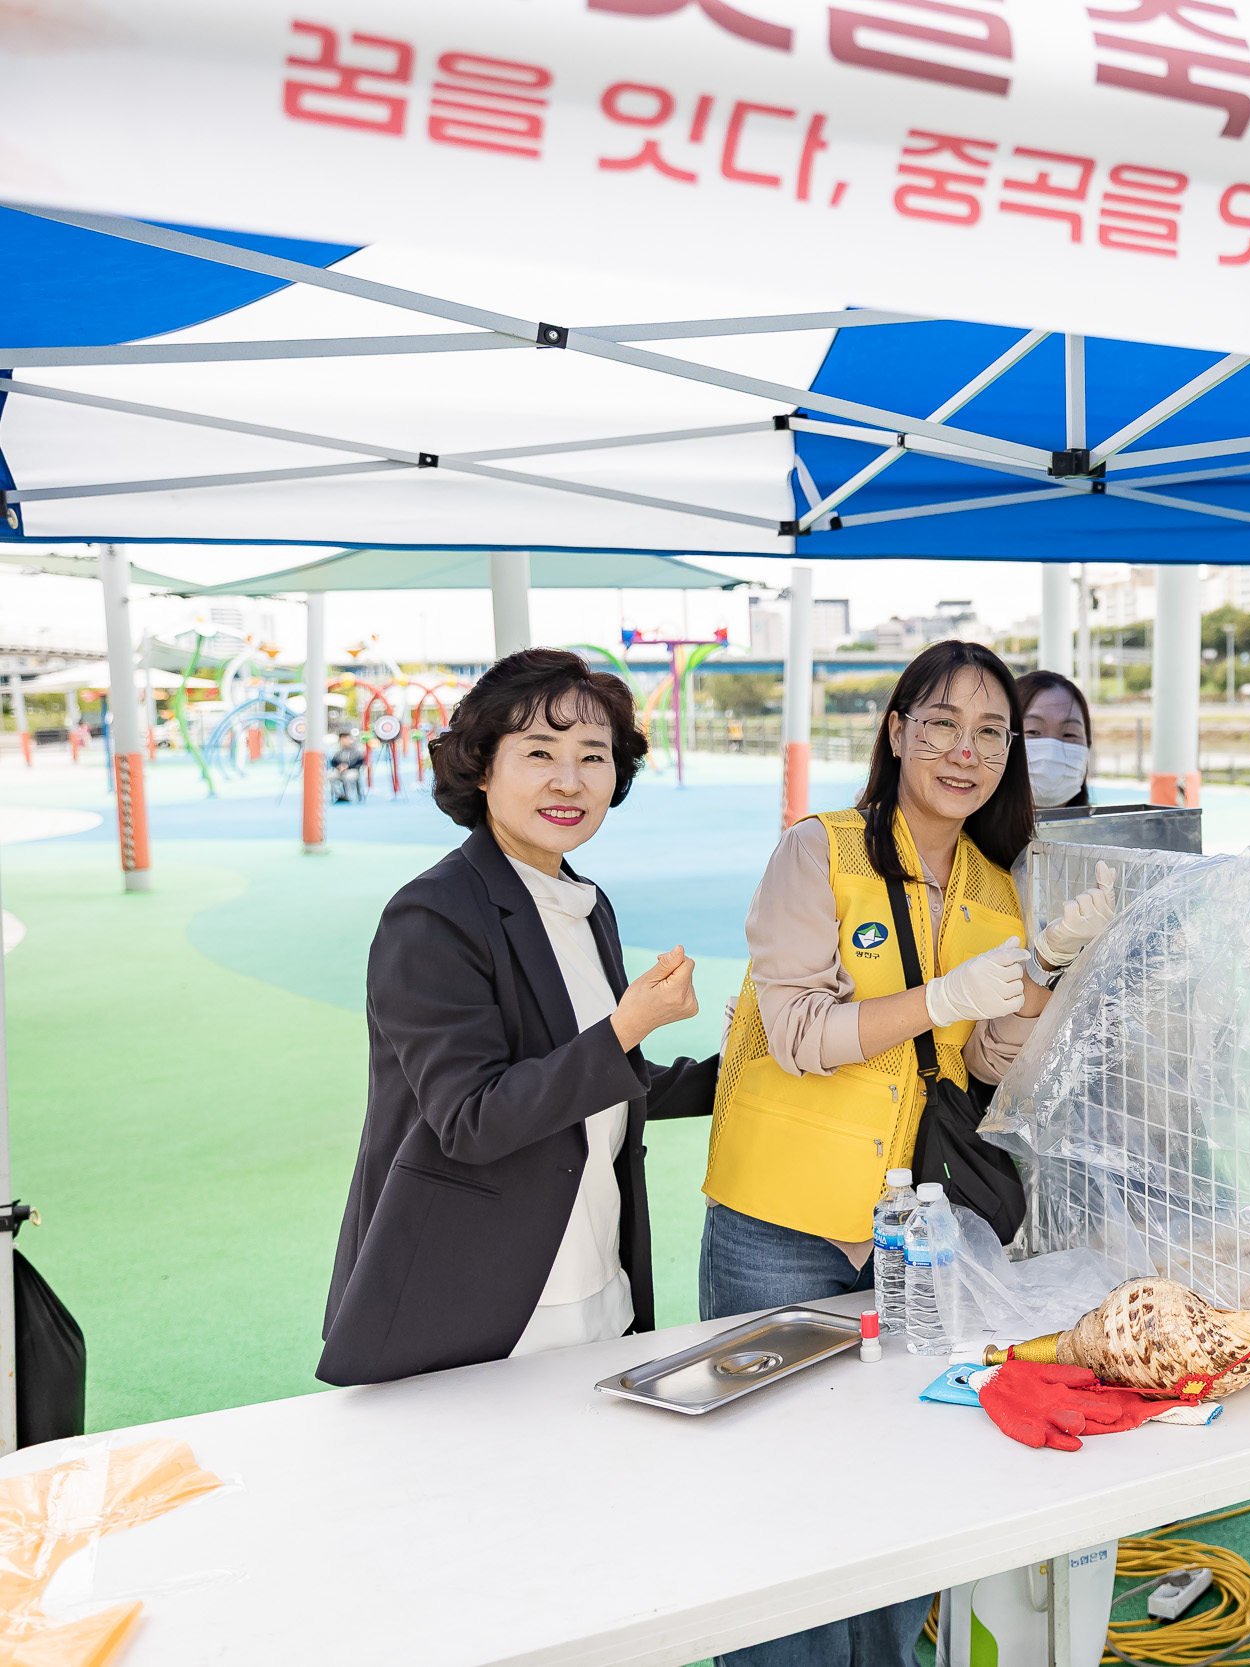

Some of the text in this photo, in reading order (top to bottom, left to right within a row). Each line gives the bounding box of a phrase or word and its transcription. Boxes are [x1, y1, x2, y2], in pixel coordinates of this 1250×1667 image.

[284, 20, 554, 160] 꿈을
[598, 80, 849, 208] 잇다,
[893, 128, 1190, 259] 중곡을
